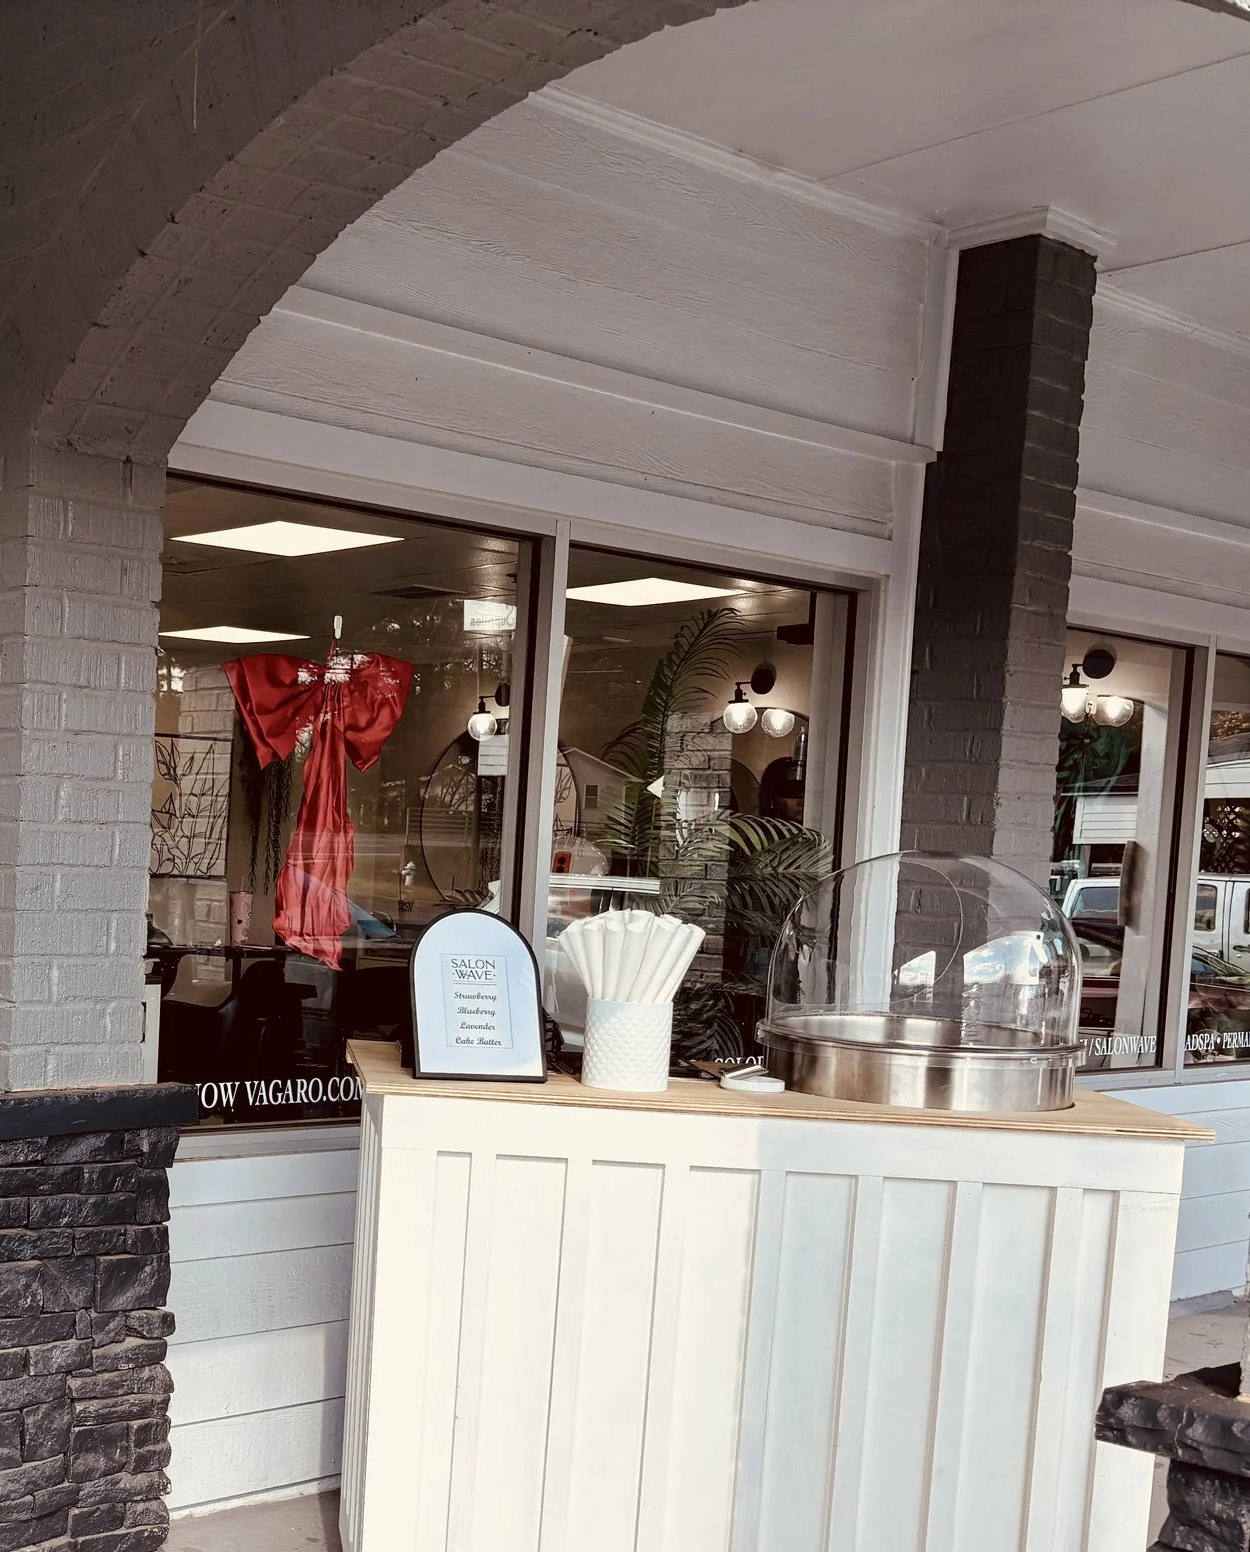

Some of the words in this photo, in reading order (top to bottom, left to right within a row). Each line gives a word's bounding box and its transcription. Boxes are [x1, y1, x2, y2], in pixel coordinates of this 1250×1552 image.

[451, 958, 496, 970] SALON
[455, 969, 493, 981] WAVE
[453, 992, 498, 1003] Strawberry
[456, 1006, 496, 1018] Blueberry
[459, 1021, 496, 1031] Lavender
[455, 1036, 476, 1045] Cake
[476, 1036, 503, 1047] Batter
[1222, 1031, 1250, 1049] PERMA
